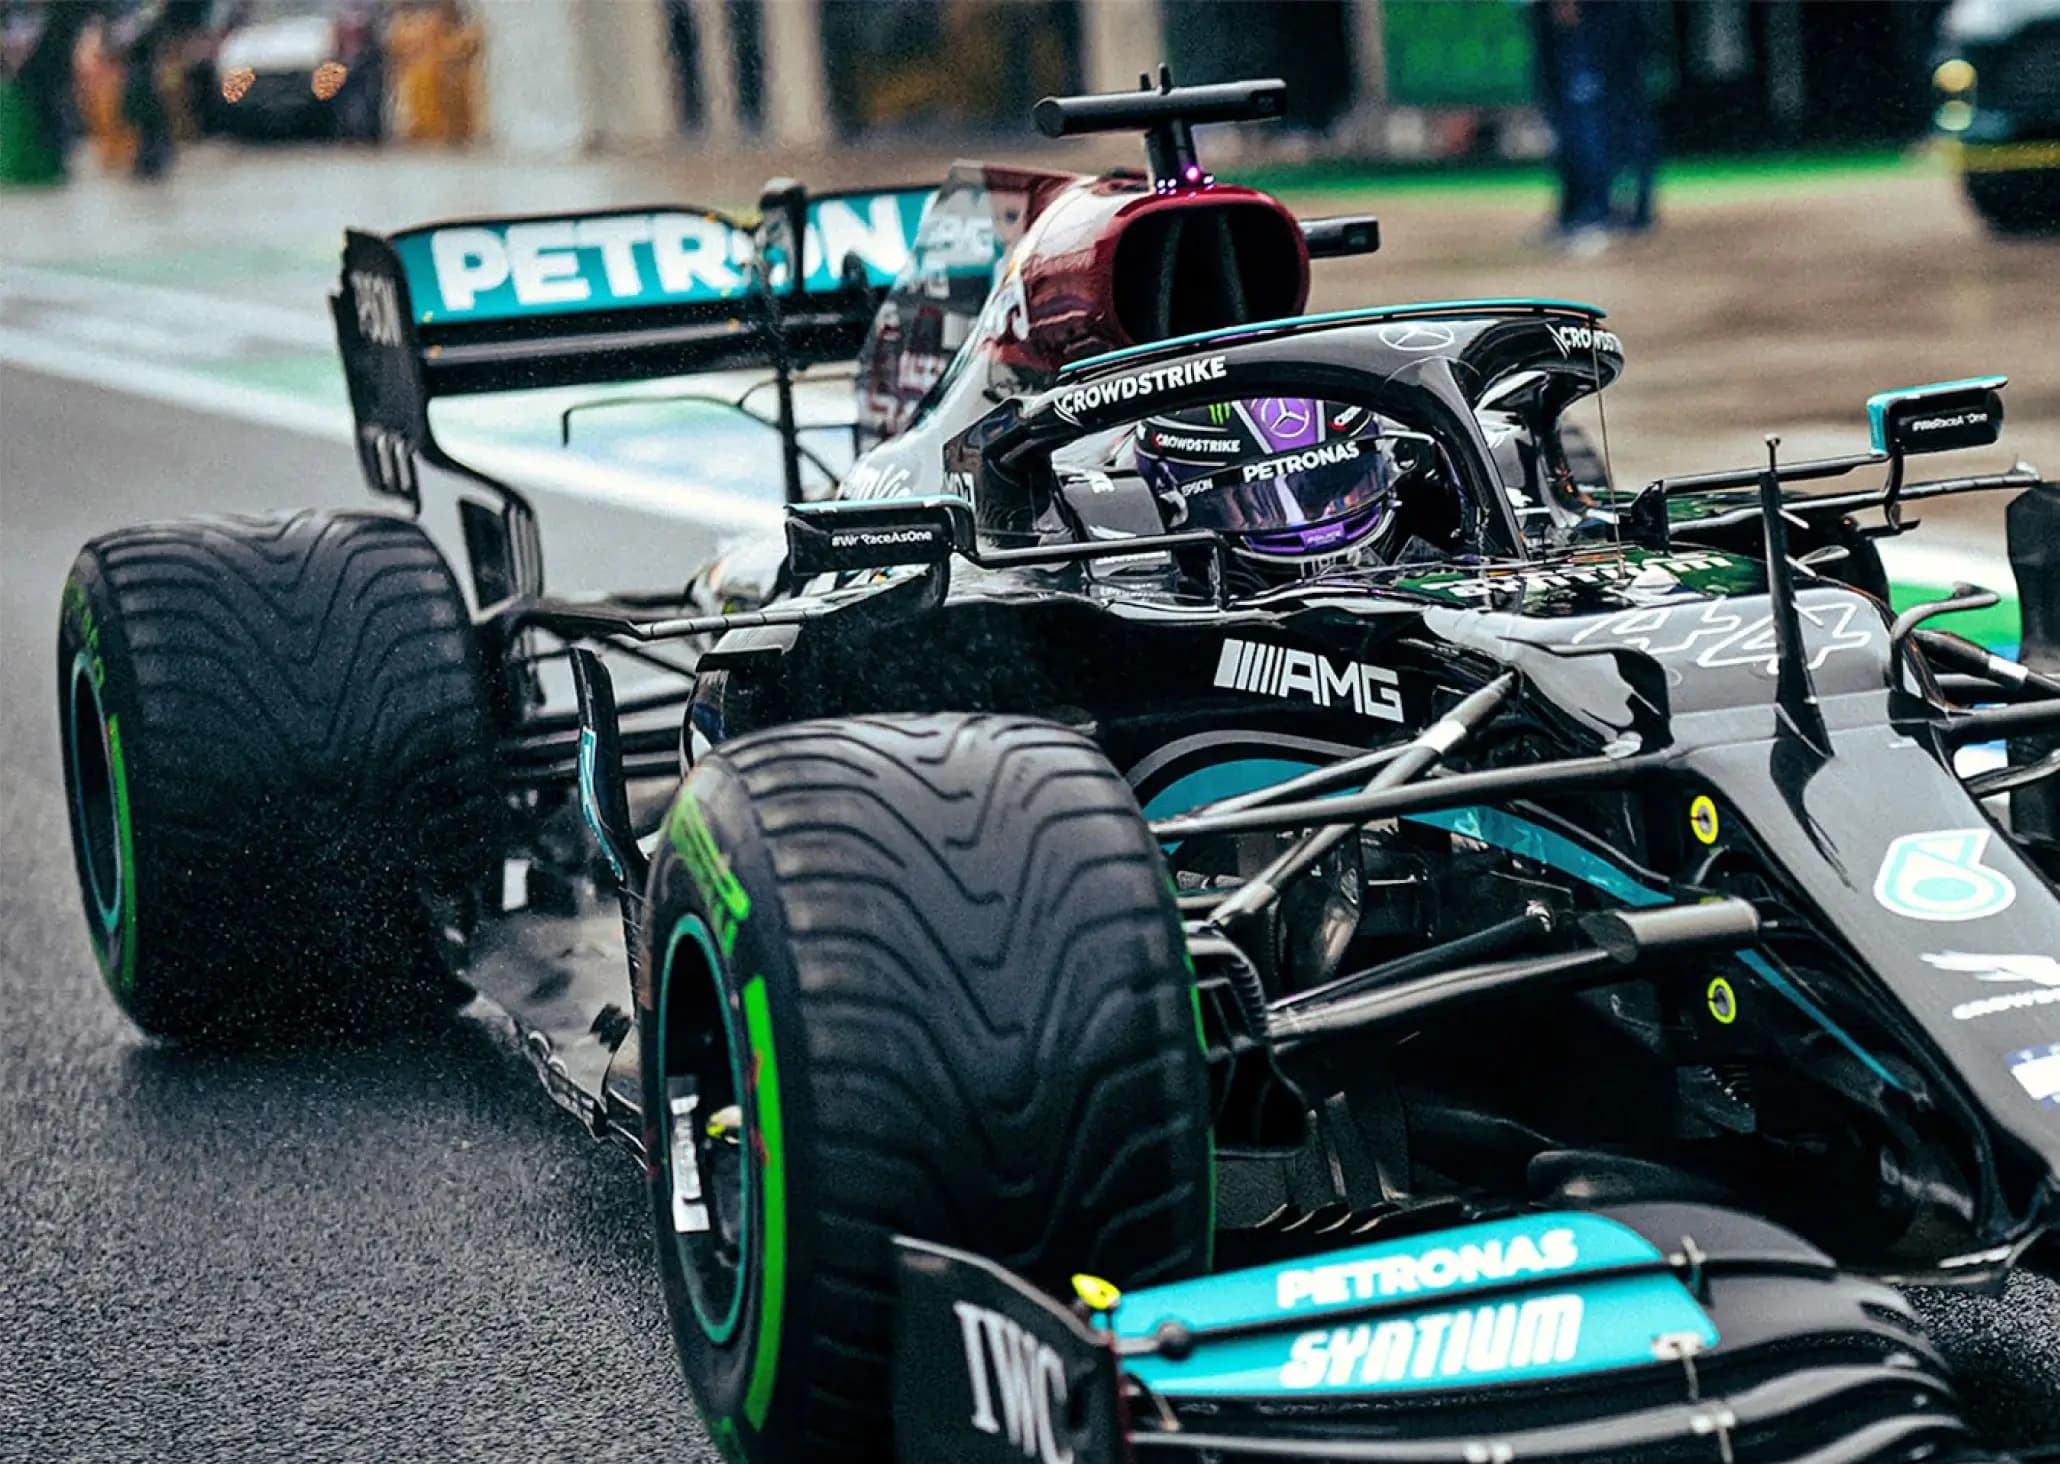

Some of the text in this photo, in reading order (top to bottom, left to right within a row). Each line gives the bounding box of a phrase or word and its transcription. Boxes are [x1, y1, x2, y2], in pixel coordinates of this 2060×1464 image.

[1060, 355, 1228, 416] CROWDSTRIKE
[1155, 433, 1241, 453] CROWDSTRIKE
[1242, 440, 1359, 483] PETRONAS
[1180, 477, 1214, 497] EPSON
[1277, 648, 1405, 724] AMG
[1276, 1228, 1579, 1309] PETRONAS
[1279, 1293, 1585, 1389] SYNTIUM
